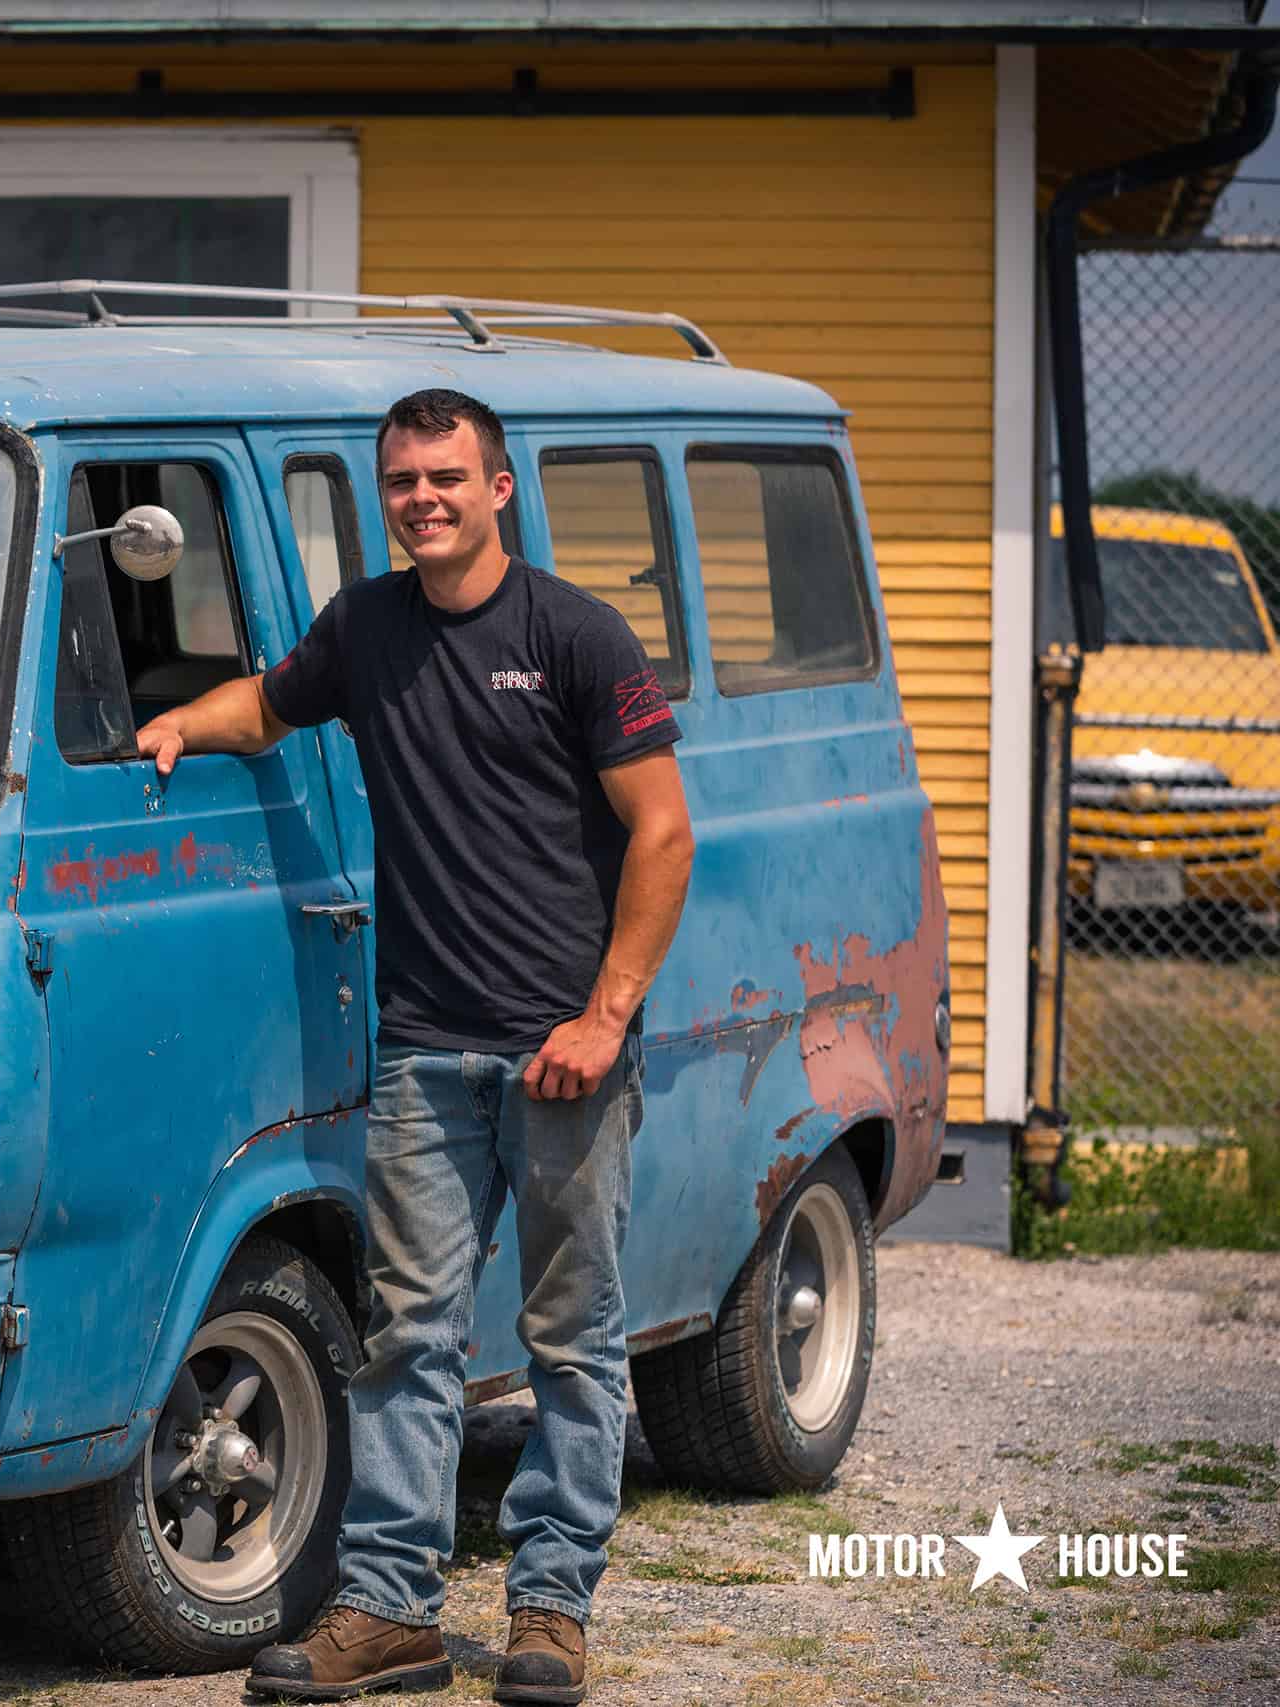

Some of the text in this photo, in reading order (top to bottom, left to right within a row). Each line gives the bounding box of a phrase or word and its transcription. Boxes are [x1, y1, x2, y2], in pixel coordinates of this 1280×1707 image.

[239, 1279, 321, 1333] RADIAL
[133, 1476, 281, 1638] COOPER COBRA
